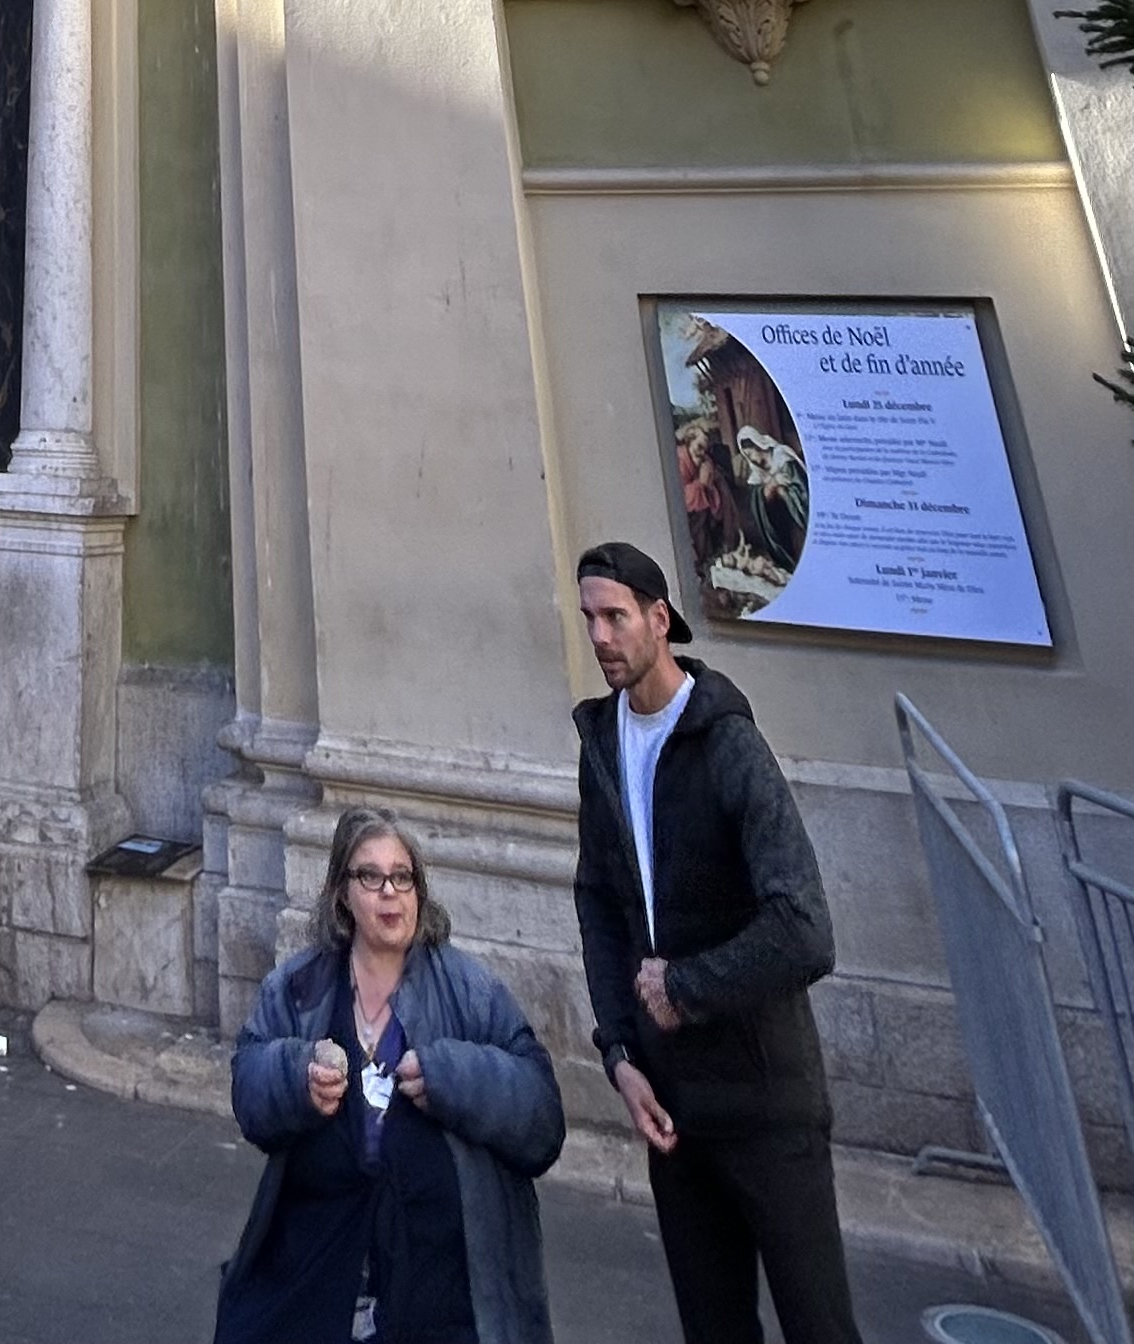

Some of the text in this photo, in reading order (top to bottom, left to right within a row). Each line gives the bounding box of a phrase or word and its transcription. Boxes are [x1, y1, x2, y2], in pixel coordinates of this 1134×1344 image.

[761, 324, 891, 348] Offices de Noël
[819, 352, 966, 377] et de fin d'année
[854, 497, 906, 511] Dimanche
